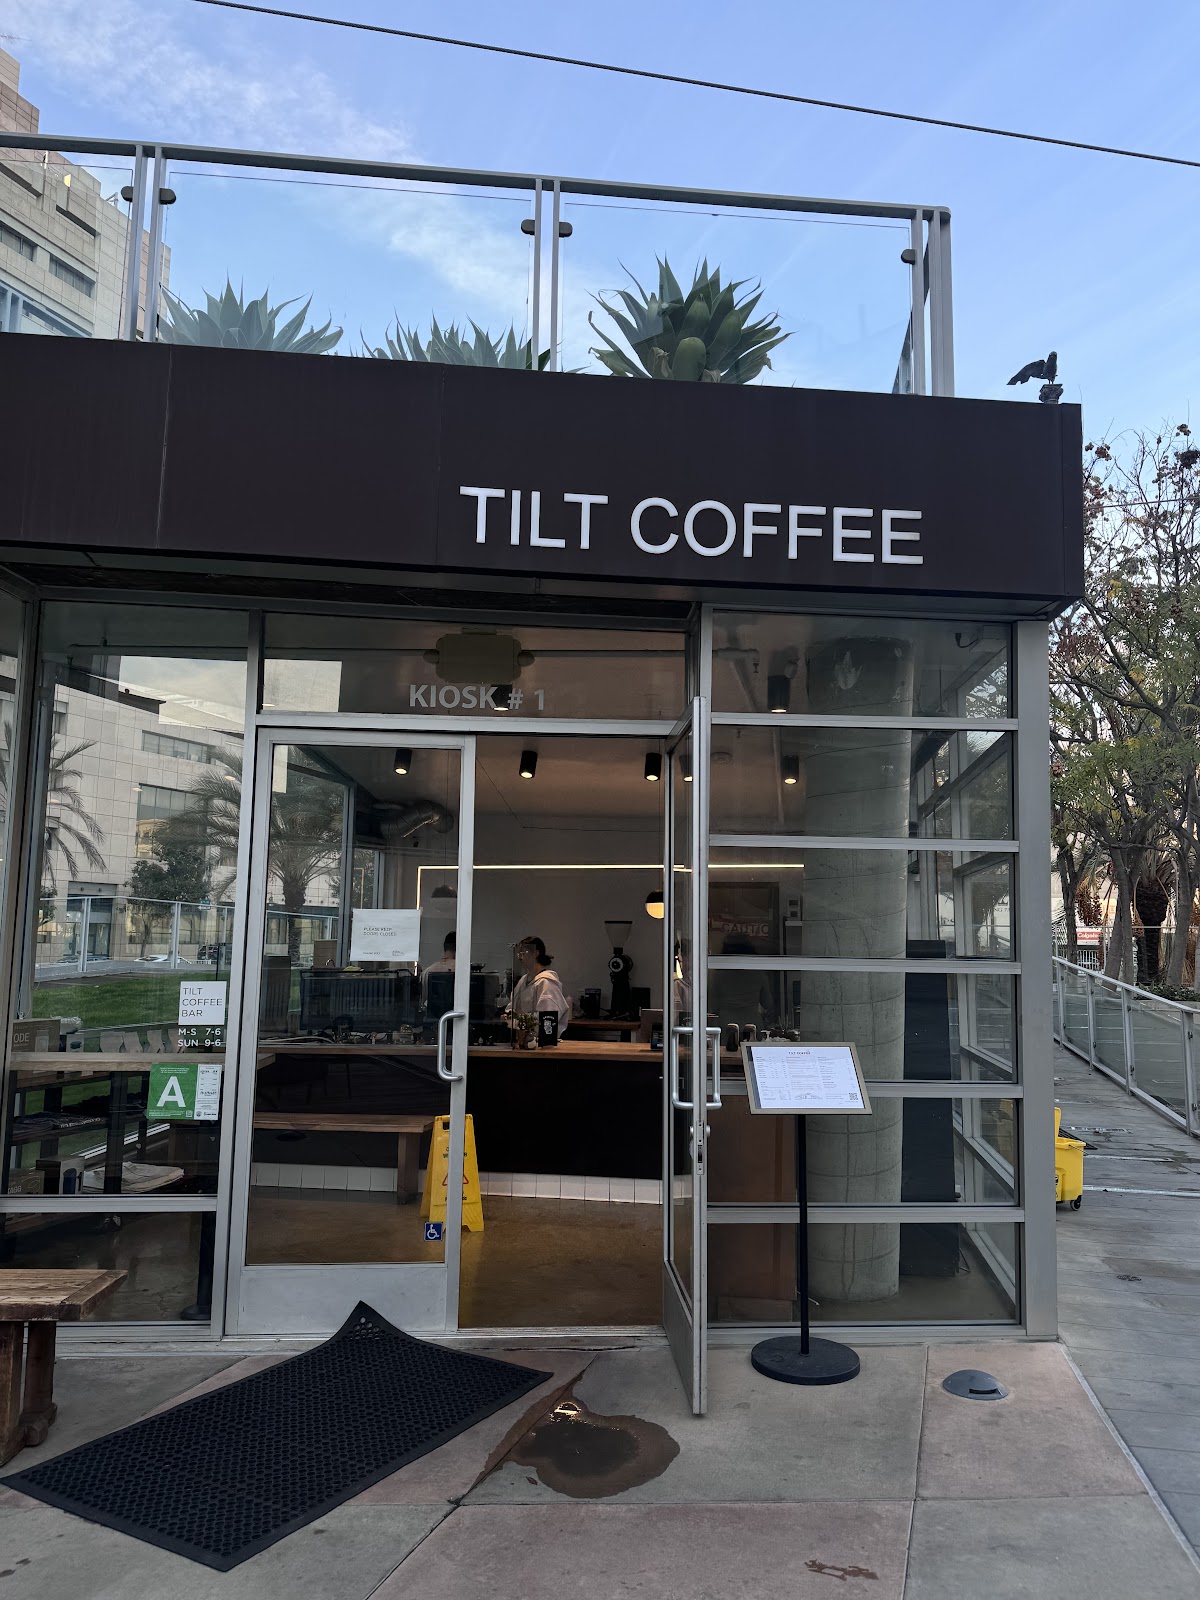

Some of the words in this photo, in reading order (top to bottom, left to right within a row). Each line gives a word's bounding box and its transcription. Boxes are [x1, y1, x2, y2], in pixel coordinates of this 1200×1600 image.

[459, 485, 609, 550] TILT
[629, 496, 924, 565] COFFEE
[409, 684, 499, 709] KIOSK
[507, 688, 524, 710] #
[534, 688, 546, 711] 1
[182, 987, 204, 996] TILT
[181, 998, 223, 1006] COFFEE
[181, 1009, 204, 1018] BAR
[178, 1027, 197, 1036] M-S
[205, 1027, 222, 1036] 7-6
[13, 1032, 30, 1043] ODE
[177, 1038, 199, 1047] SUN
[204, 1038, 222, 1047] 9-6
[156, 1075, 187, 1108] A
